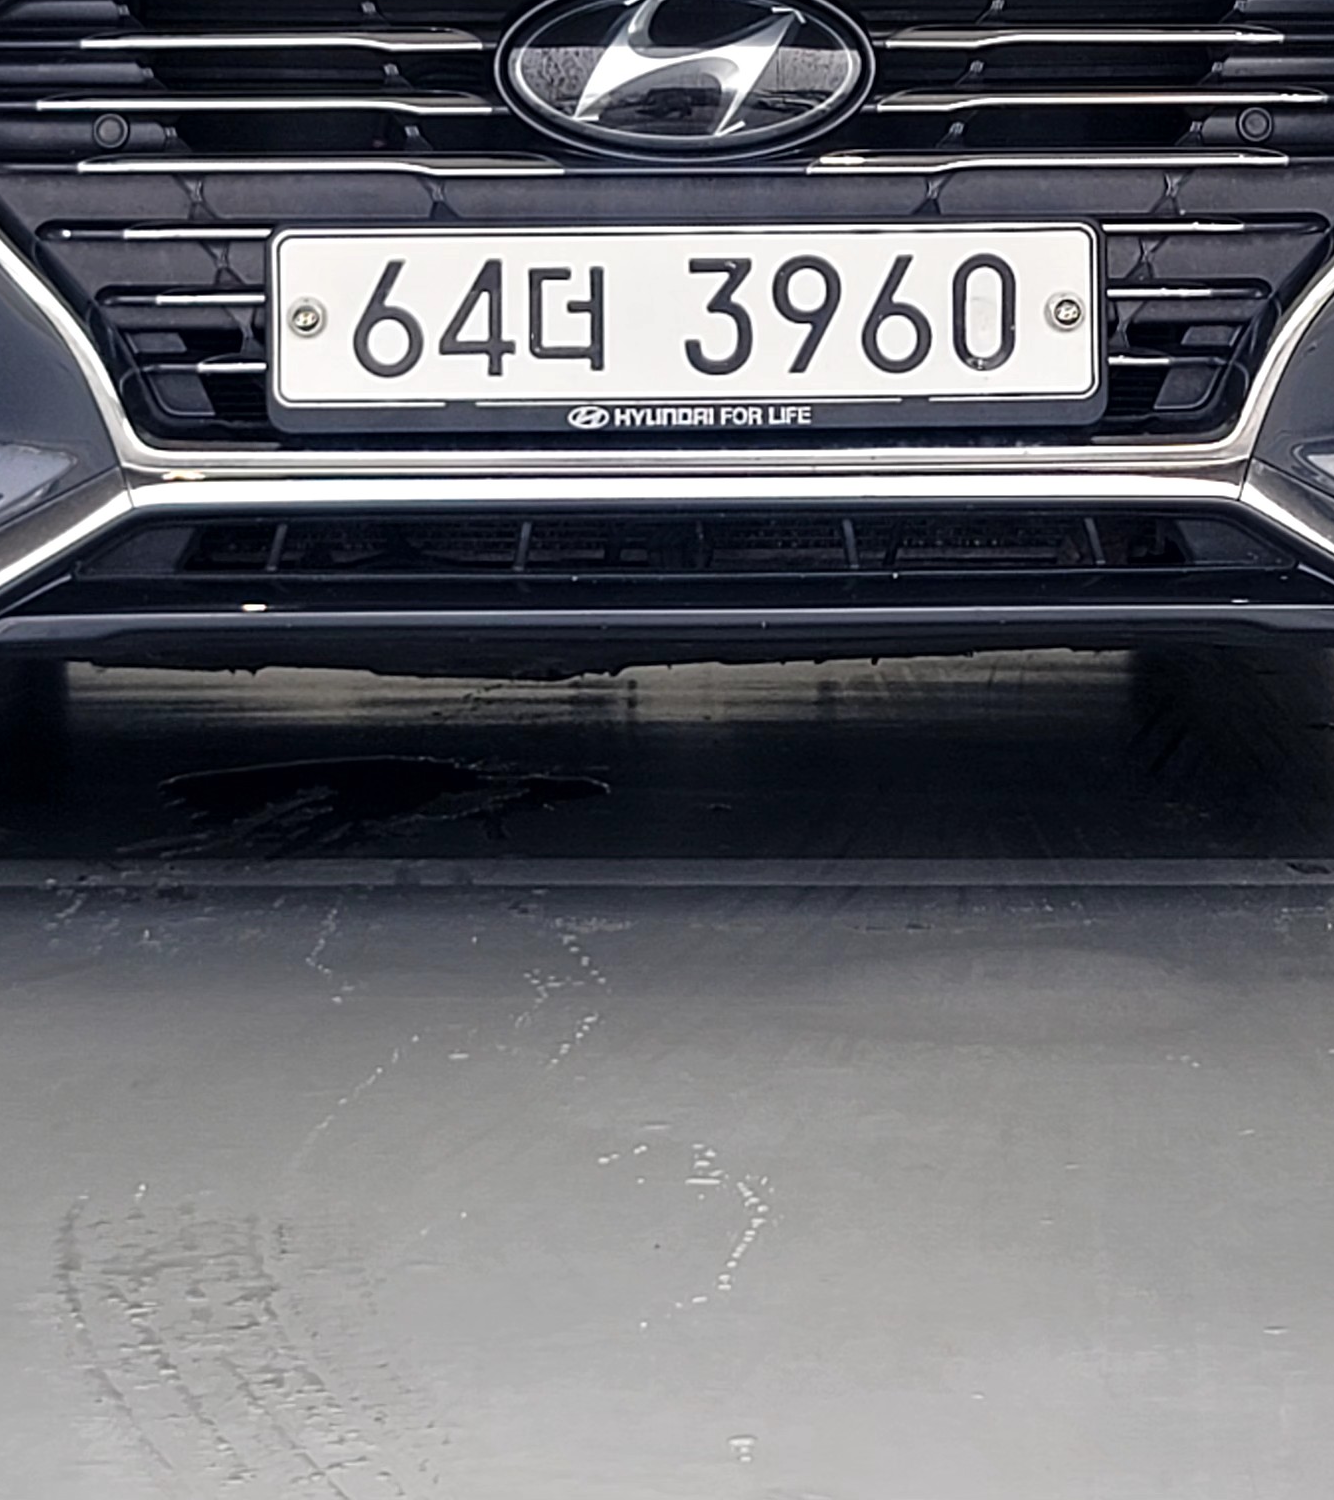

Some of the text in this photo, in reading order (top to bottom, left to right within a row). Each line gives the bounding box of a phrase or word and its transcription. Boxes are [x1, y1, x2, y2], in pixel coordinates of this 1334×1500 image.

[352, 252, 1018, 378] 64더 3960
[614, 405, 812, 427] HYUNDAI FOR LIFE
